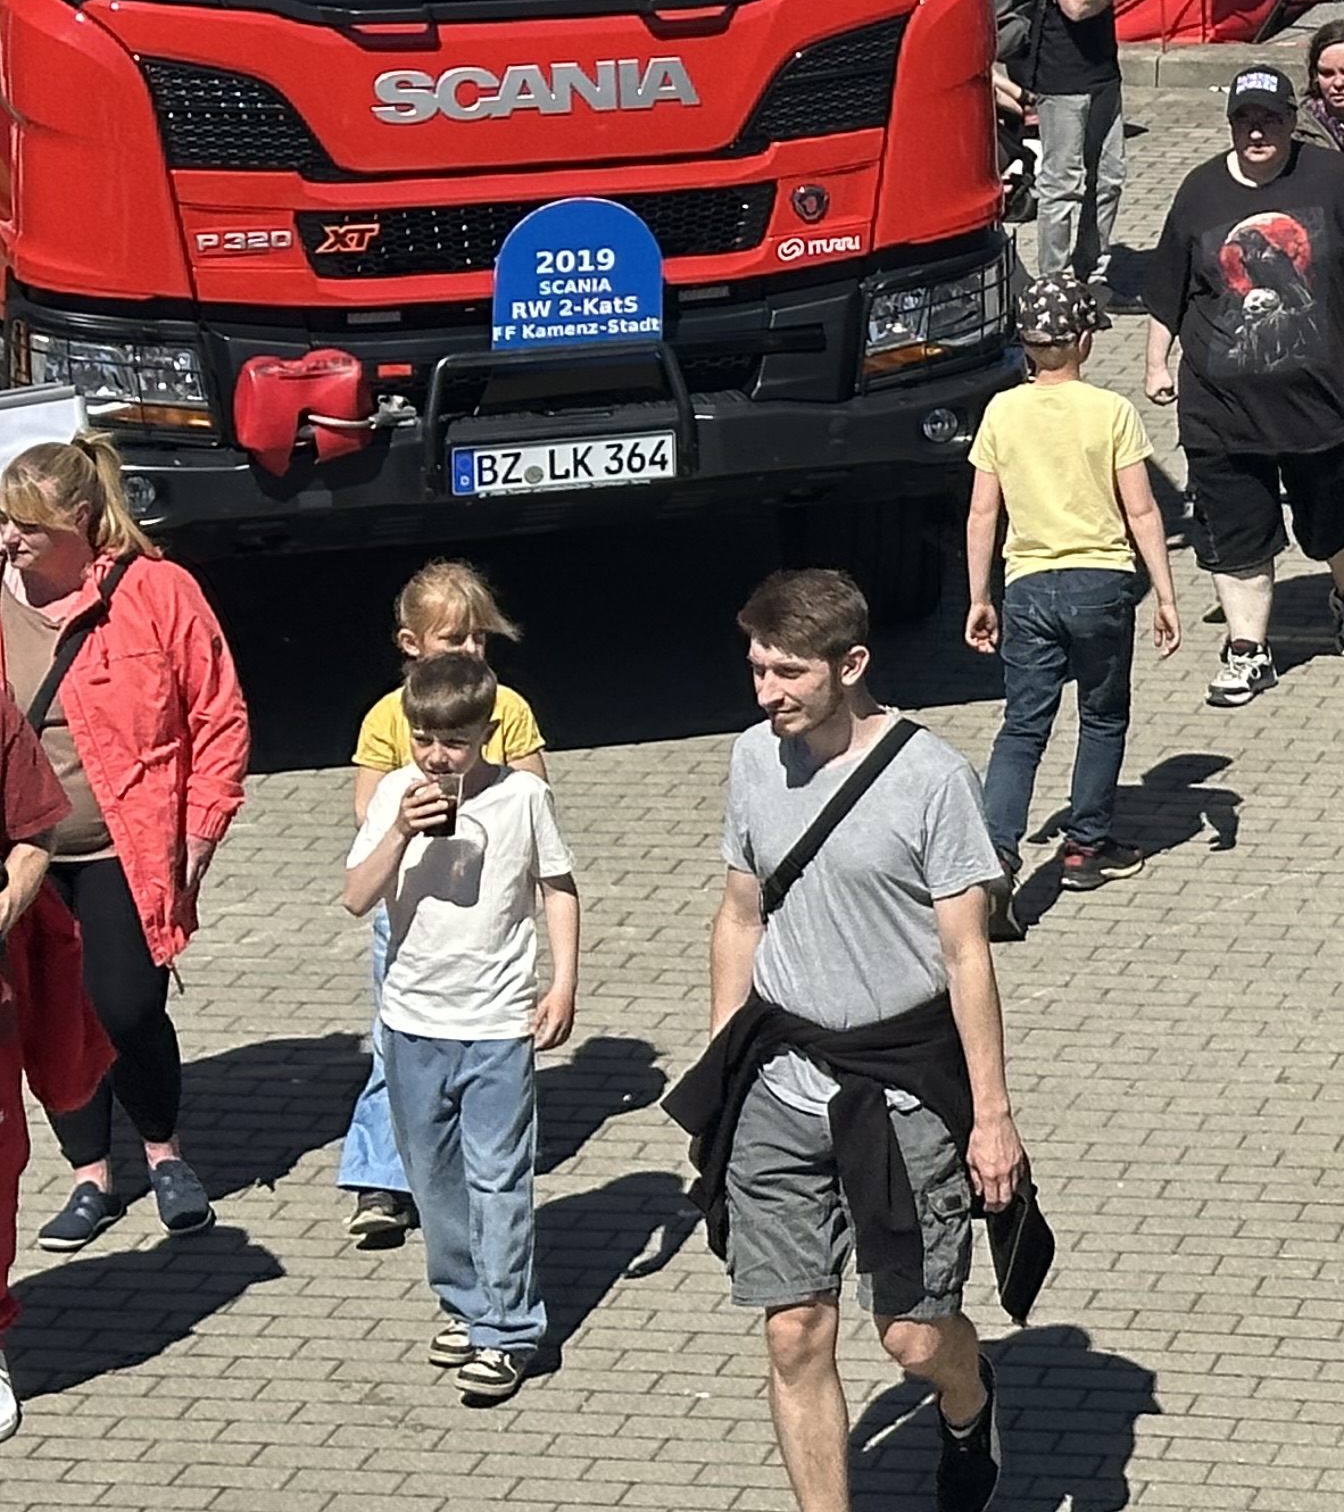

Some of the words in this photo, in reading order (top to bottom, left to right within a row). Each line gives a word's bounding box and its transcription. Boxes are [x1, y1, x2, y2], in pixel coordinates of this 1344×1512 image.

[372, 57, 701, 124] SCANIA
[196, 234, 218, 251] P
[223, 230, 291, 250] 320
[315, 223, 380, 254] XT
[536, 248, 615, 274] 2019
[539, 278, 612, 295] SCANIA
[511, 300, 551, 320] RW
[558, 296, 638, 317] 2-KatS
[522, 318, 660, 339] Kamenz-Stadt
[477, 452, 522, 487] BZ
[550, 445, 593, 480] LK
[604, 439, 668, 475] 364
[460, 475, 470, 486] D
